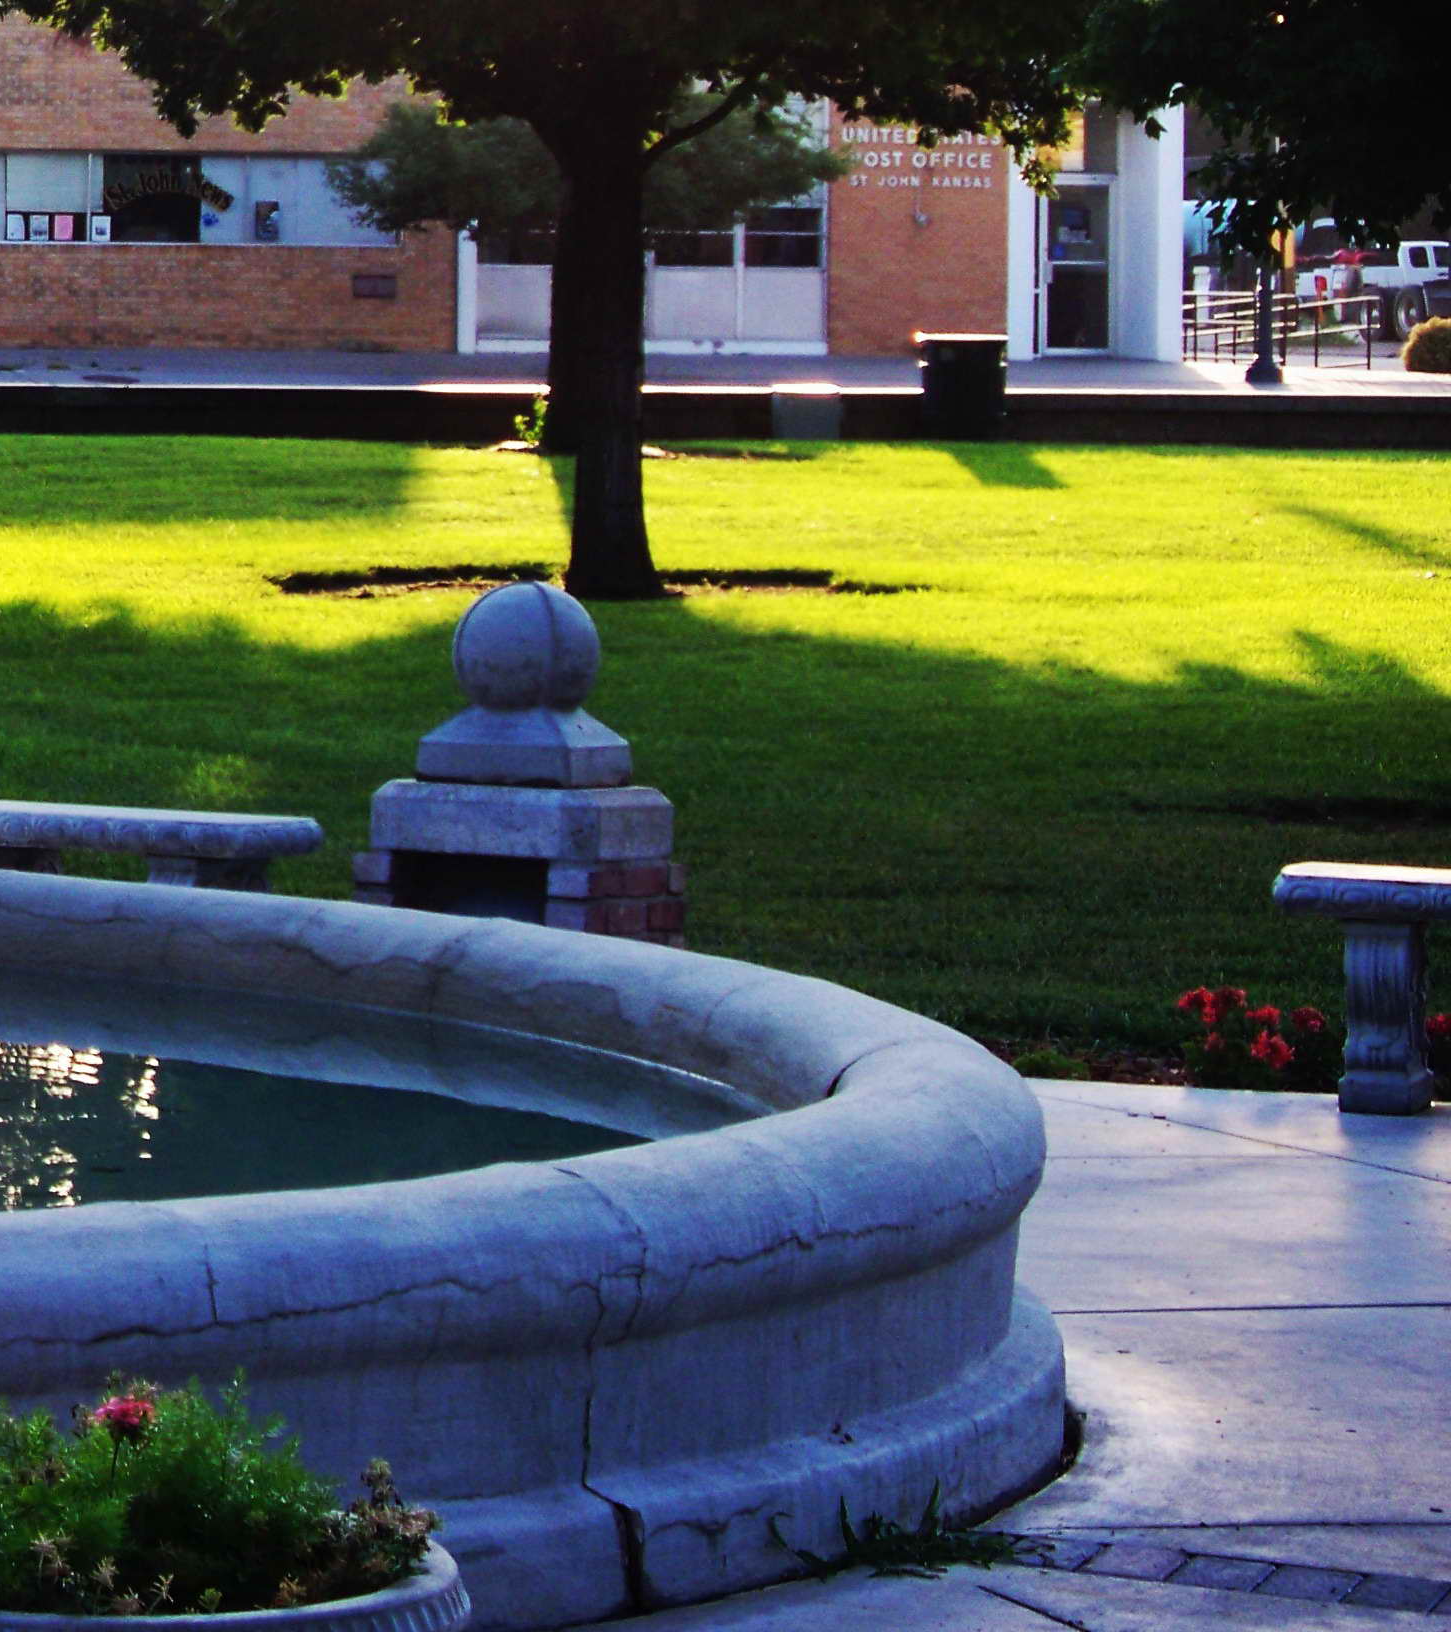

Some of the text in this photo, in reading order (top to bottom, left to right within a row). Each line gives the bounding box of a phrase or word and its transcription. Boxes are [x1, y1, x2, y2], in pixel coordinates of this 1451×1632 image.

[842, 127, 918, 144] UNITED
[912, 151, 992, 168] OFFICE
[134, 167, 182, 194] John
[877, 175, 920, 187] JOHN
[931, 176, 992, 188] KANSAS
